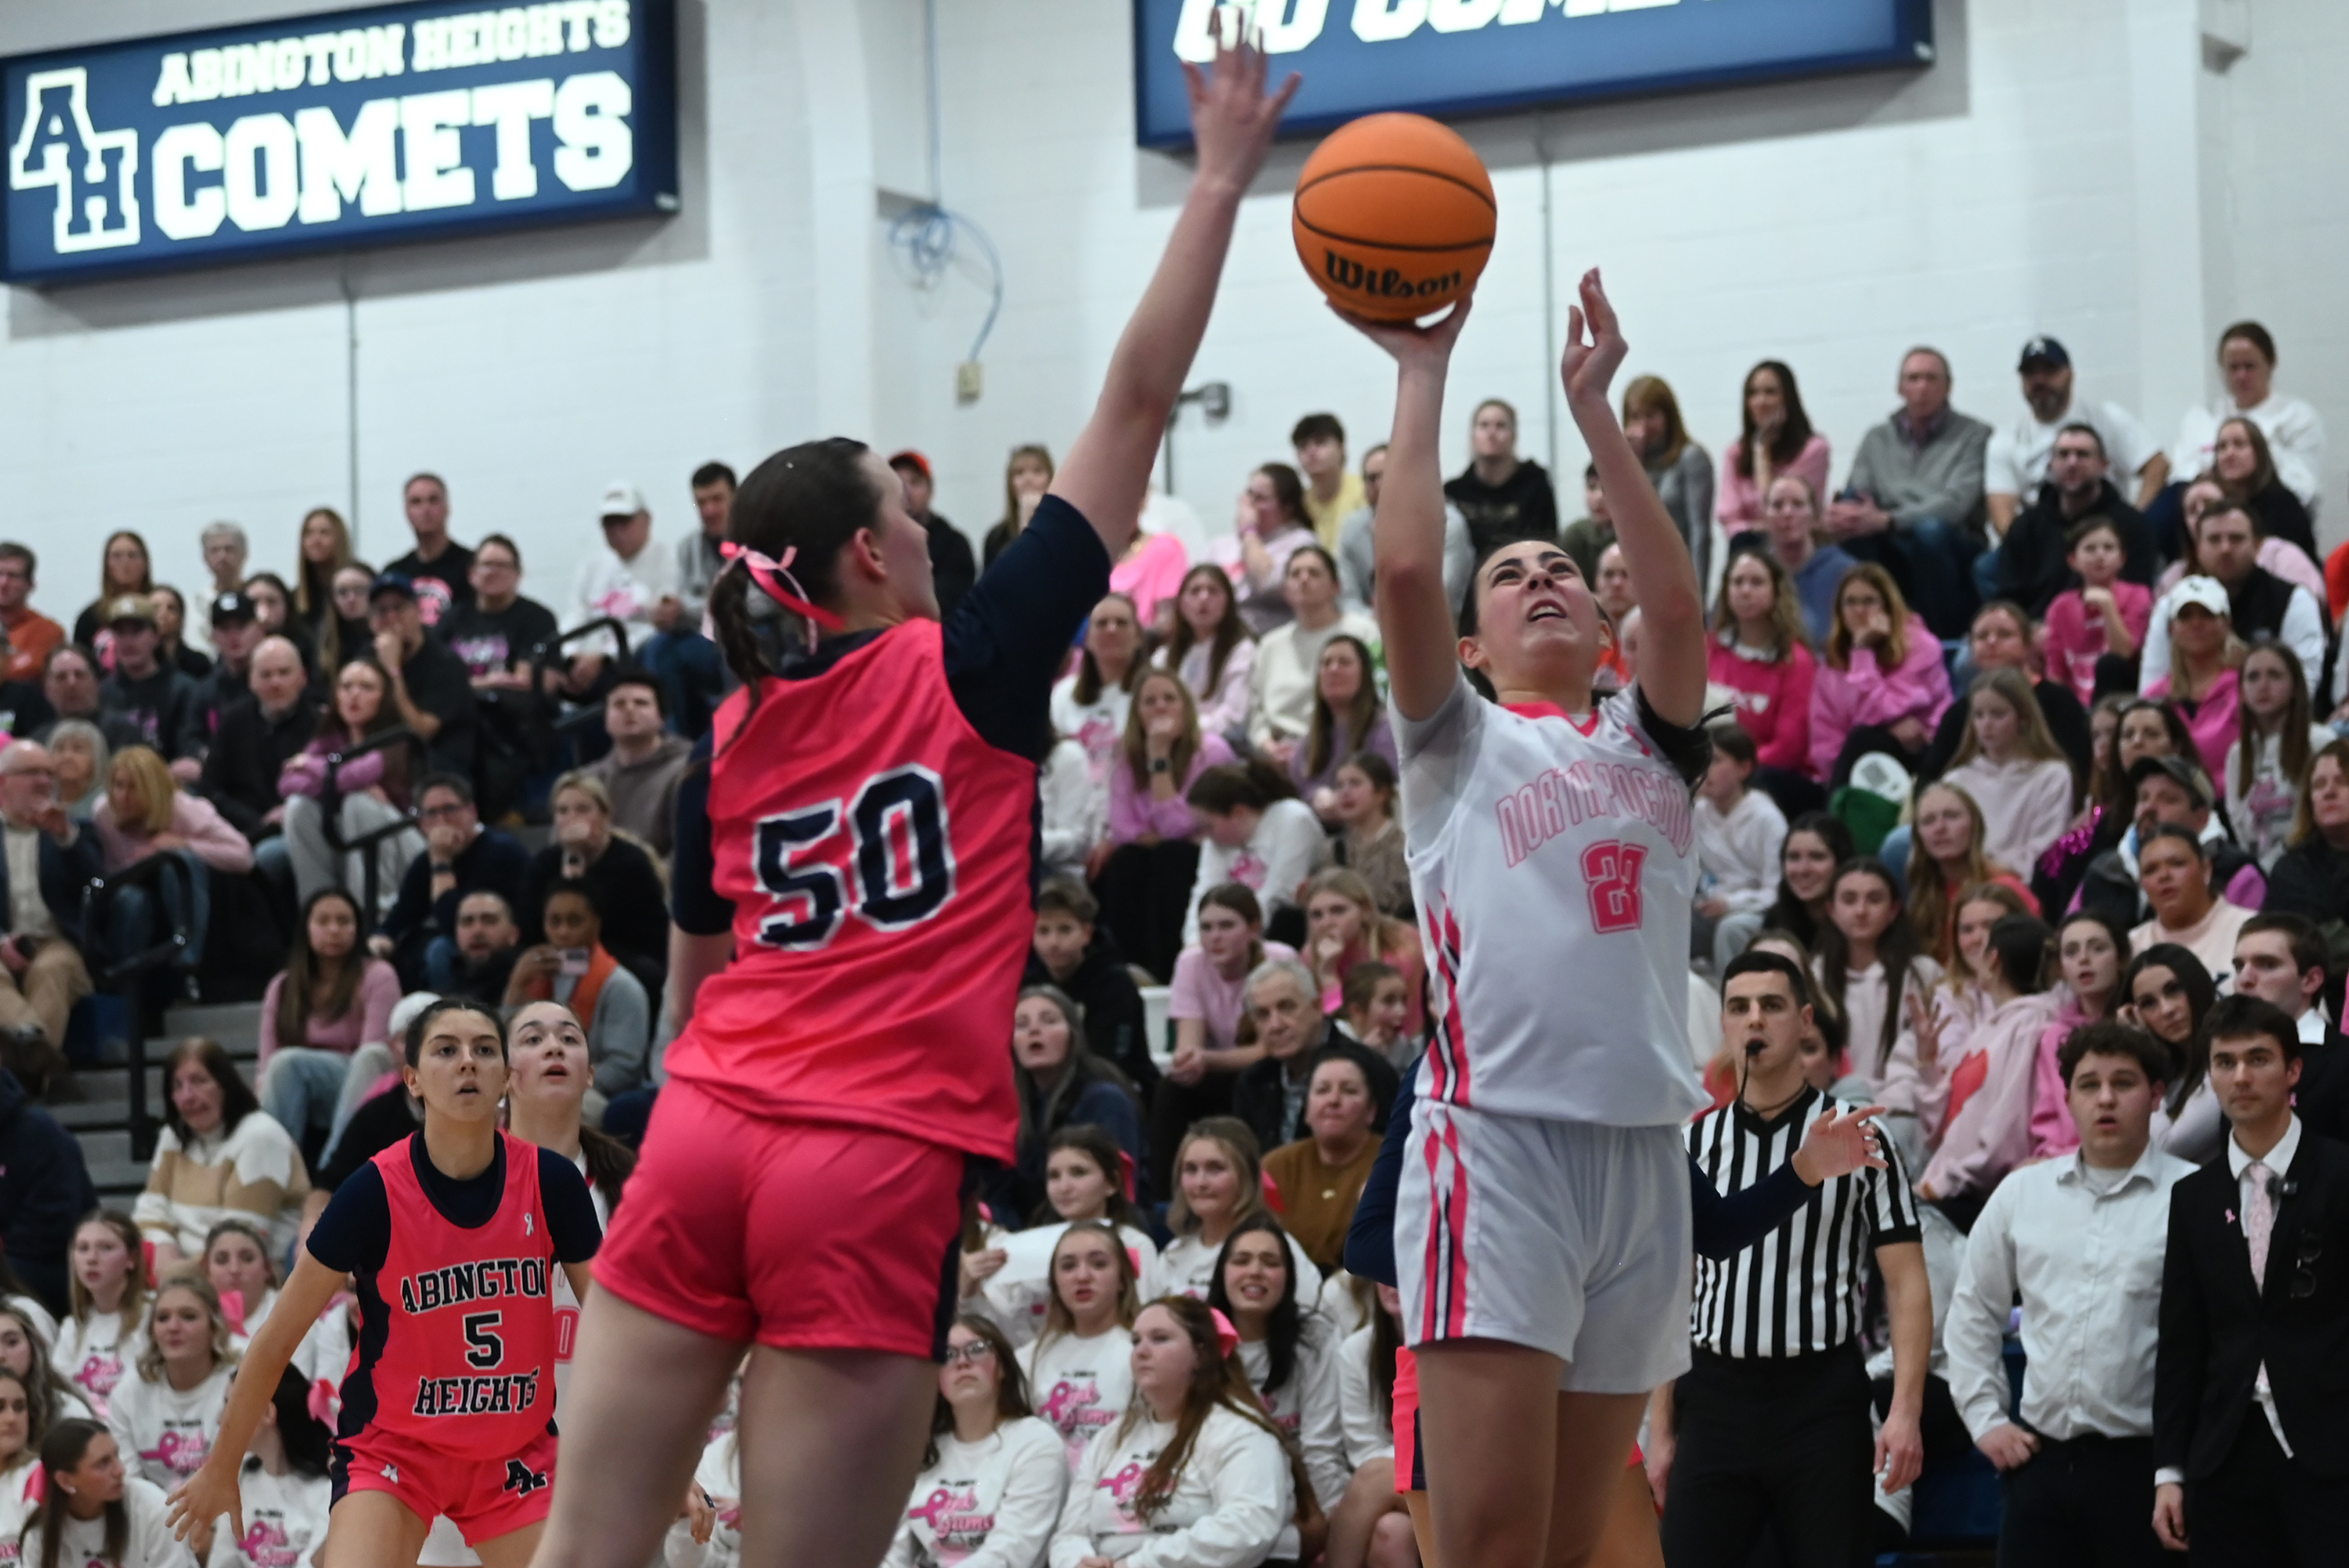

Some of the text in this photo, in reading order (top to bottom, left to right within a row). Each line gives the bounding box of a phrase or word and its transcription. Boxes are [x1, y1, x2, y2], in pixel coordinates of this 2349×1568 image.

[153, 0, 631, 106] ABINGTON HEIGHTS
[152, 71, 632, 241] COMETS
[1326, 250, 1462, 297] Wilson
[752, 761, 957, 951] 50
[463, 1310, 503, 1370] 5
